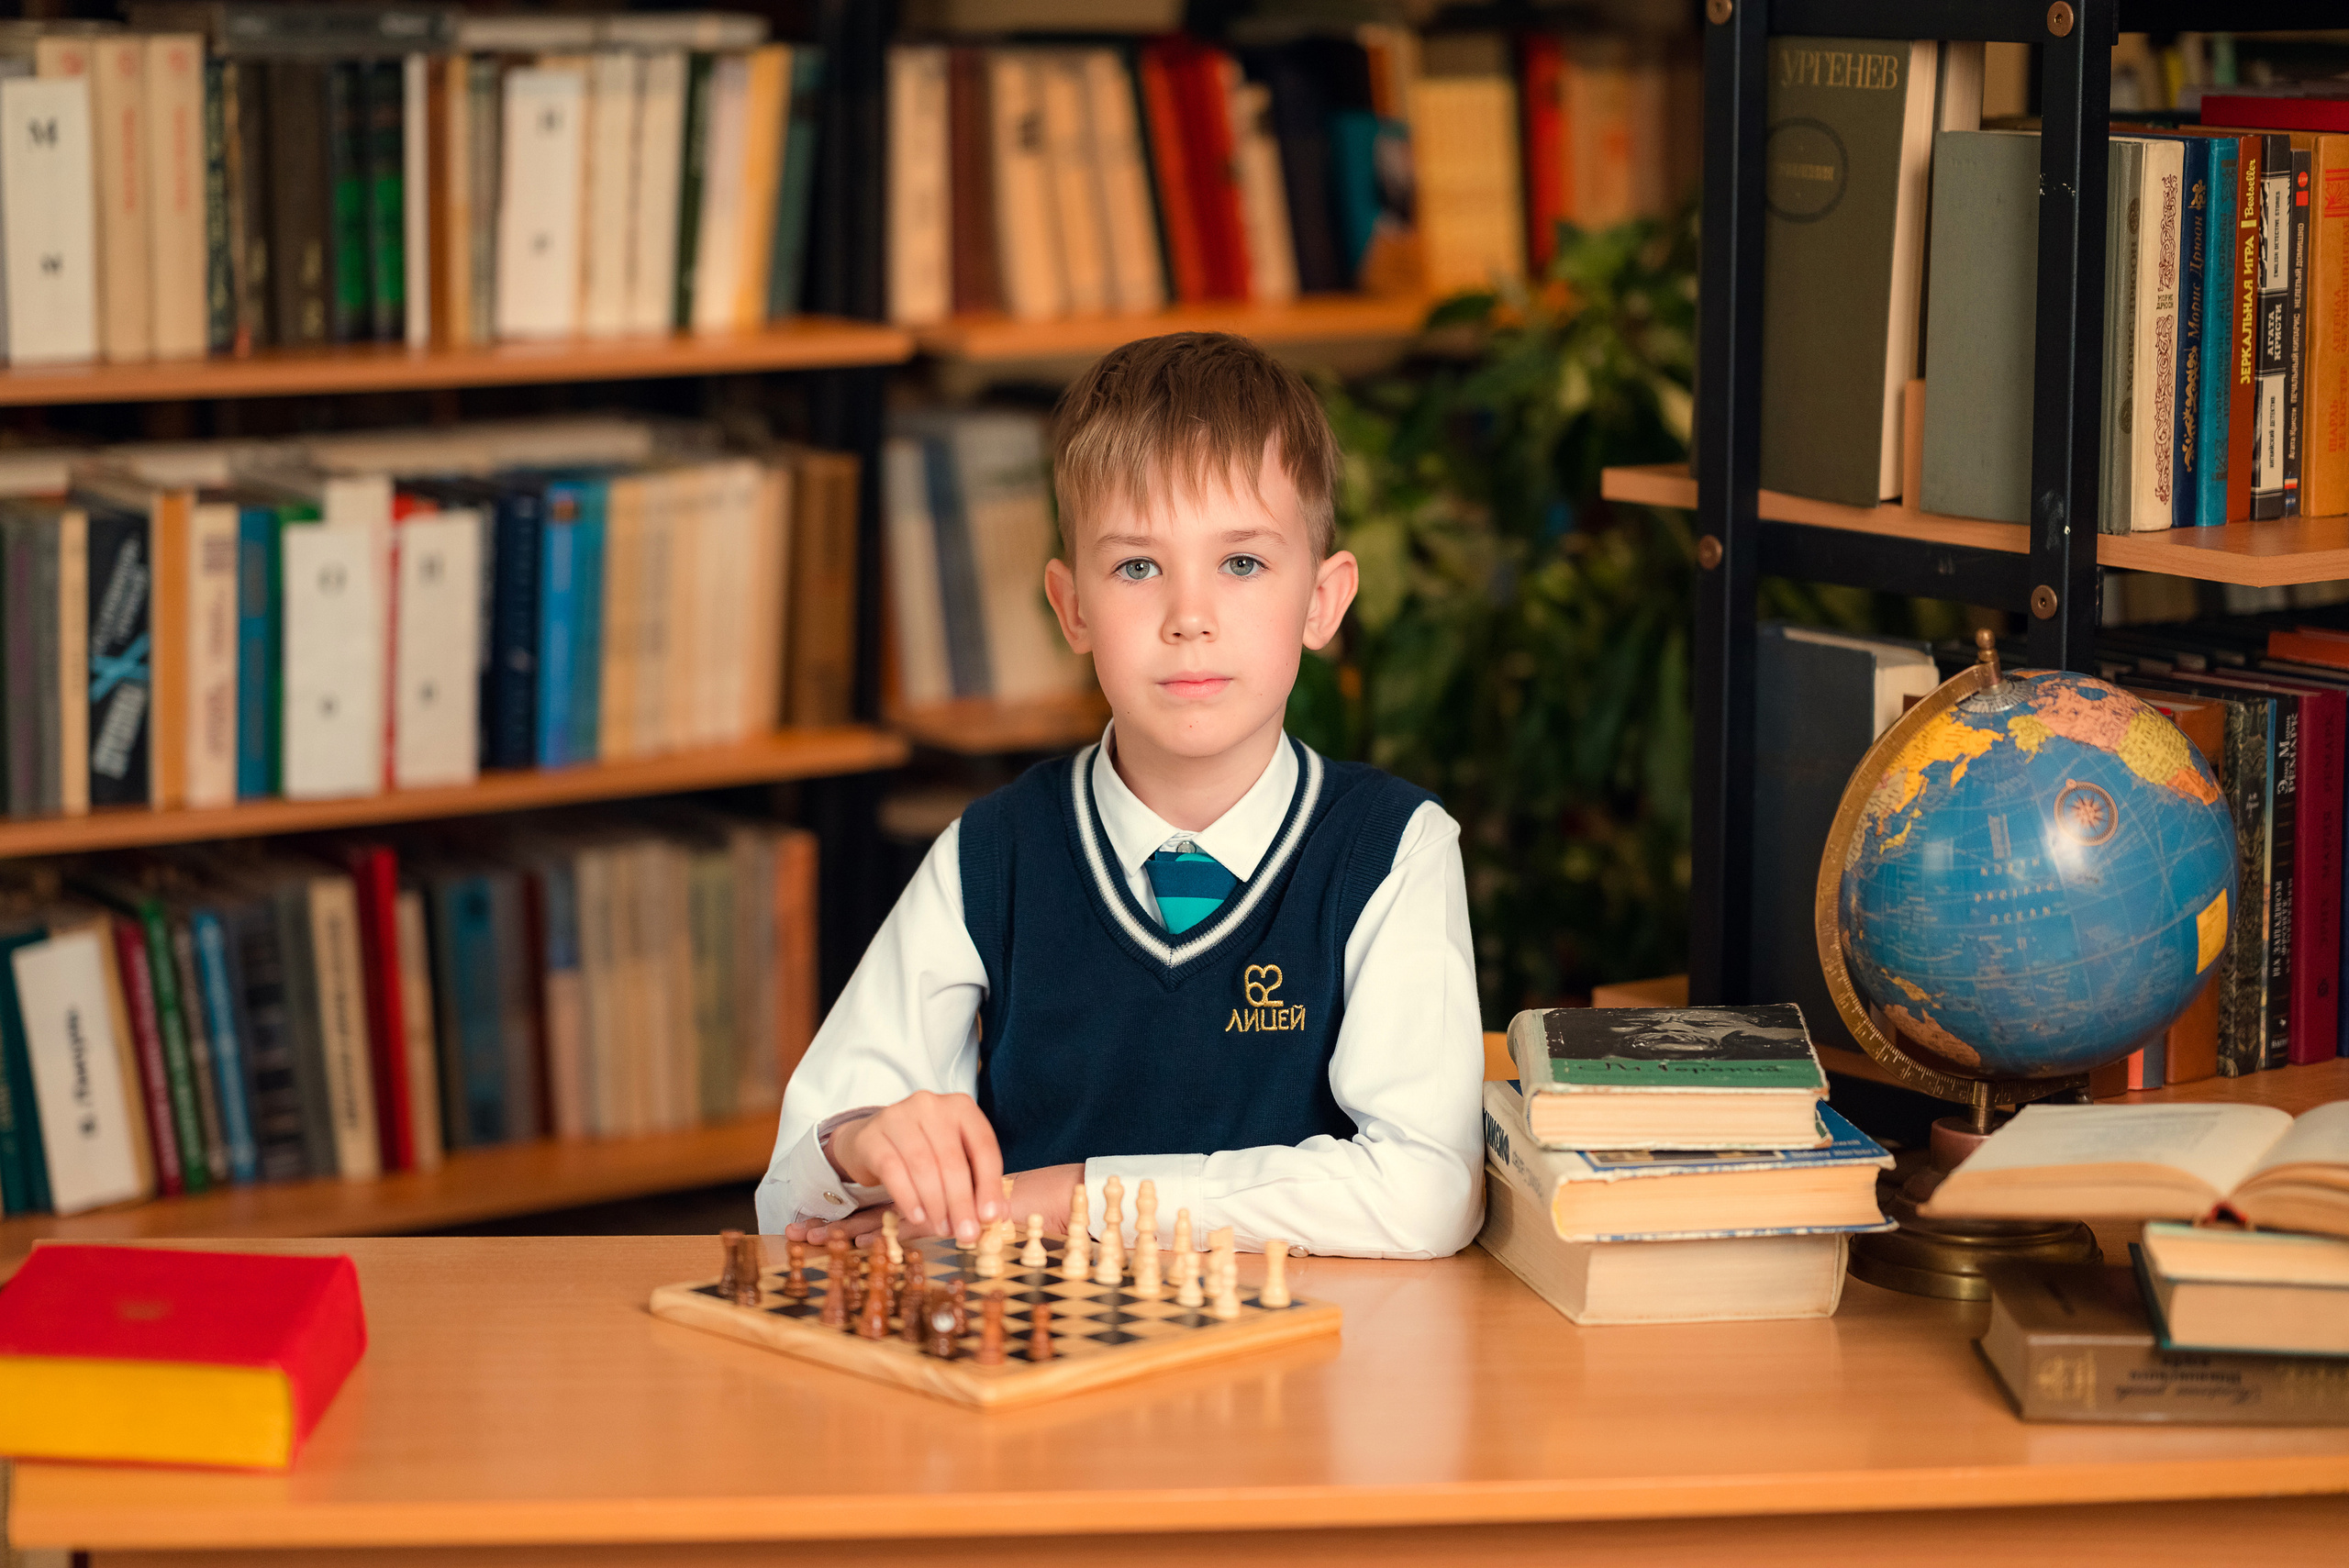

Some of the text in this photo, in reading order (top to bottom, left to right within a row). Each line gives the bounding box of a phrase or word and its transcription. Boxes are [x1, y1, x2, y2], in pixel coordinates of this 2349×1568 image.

[1779, 50, 1898, 90] УРГЕНЕВ
[2243, 158, 2256, 219] Bestseller
[2187, 216, 2204, 339] Морис Дрюон
[2294, 222, 2305, 309] НЕЛЕПЫЙ ДОМИШКО
[2240, 235, 2254, 384] ЗЕРКАЛЬНАЯ ИГРА
[2274, 303, 2282, 361] КРИСТИ
[2292, 313, 2300, 352] КИПАРИС
[2290, 352, 2299, 404] ПЕЧАЛЬНЫЙ
[1989, 906, 2051, 925] OCEAN
[1244, 964, 1284, 1007] 62
[1225, 1005, 1307, 1032] ЛИЦЕЙ
